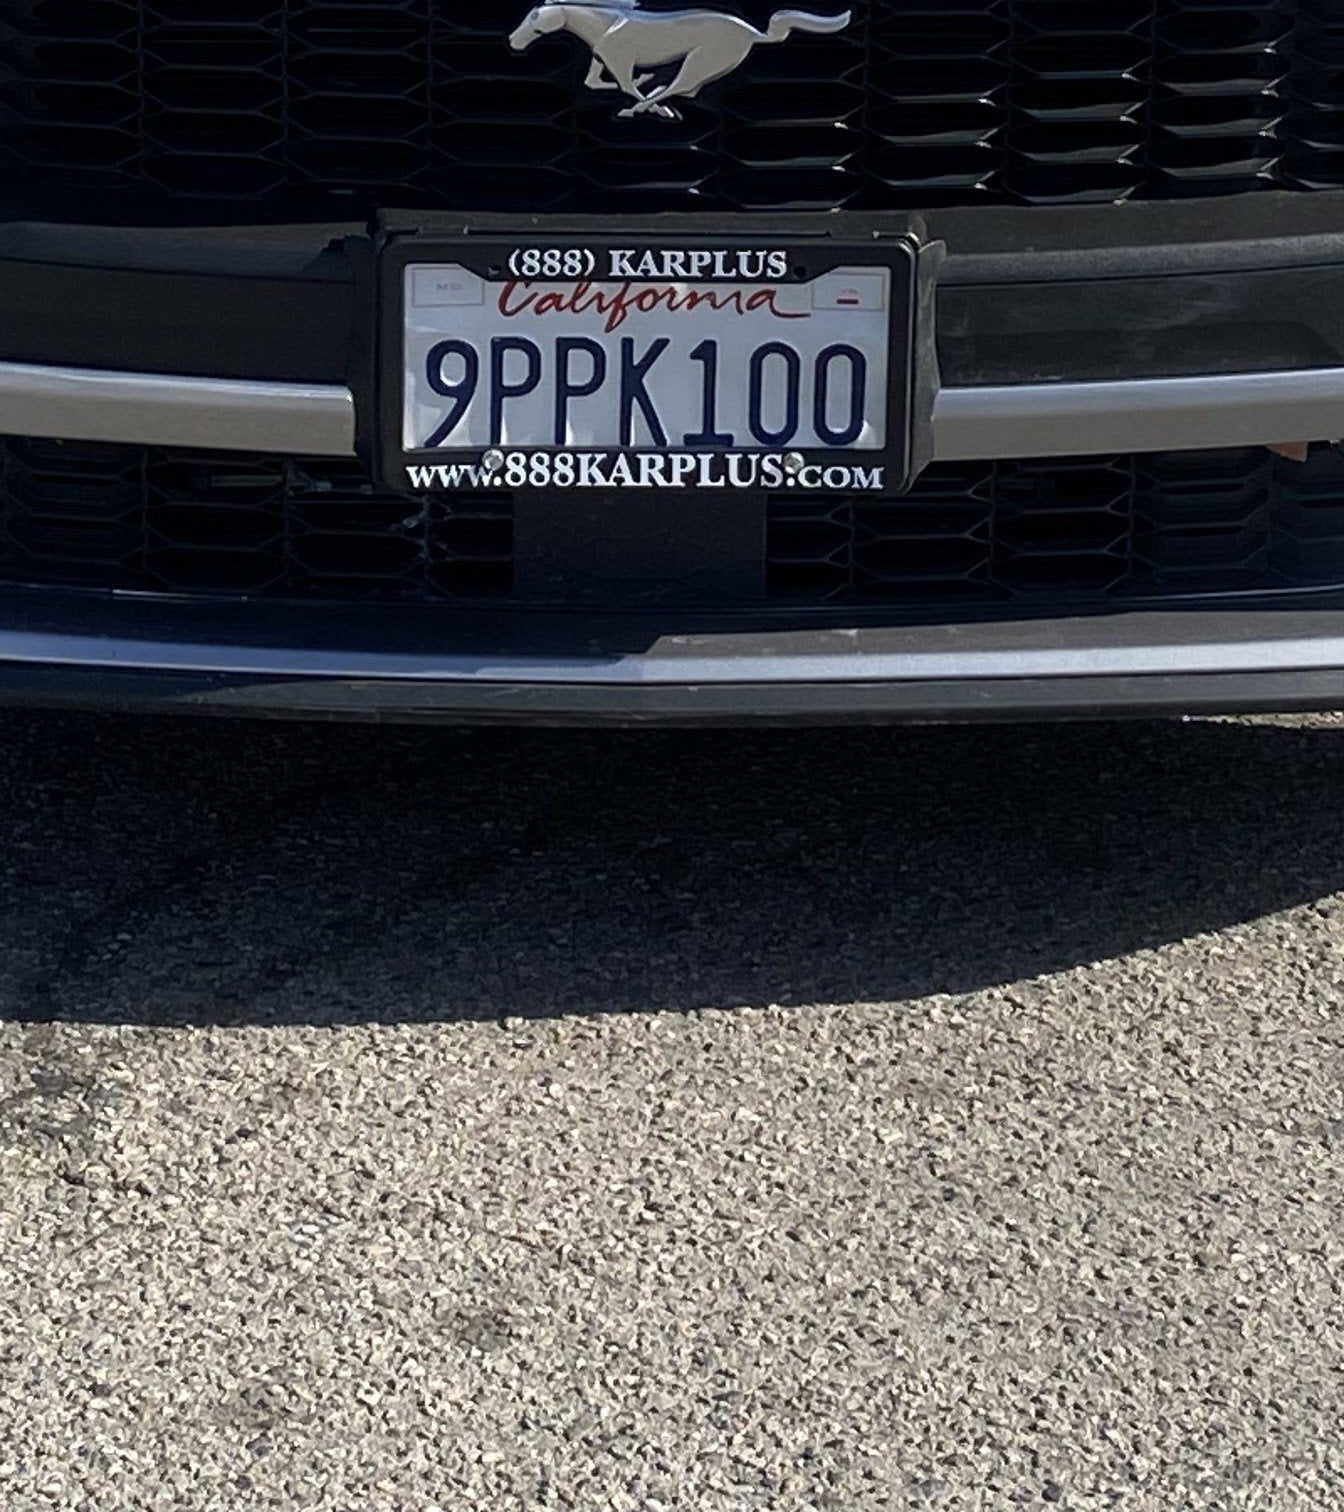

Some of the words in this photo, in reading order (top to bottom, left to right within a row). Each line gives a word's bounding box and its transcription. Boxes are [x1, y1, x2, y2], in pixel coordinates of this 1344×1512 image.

[508, 248, 596, 279] (888)
[608, 249, 788, 279] KARPLUS
[497, 279, 812, 334] California
[424, 336, 868, 449] 9PPK100
